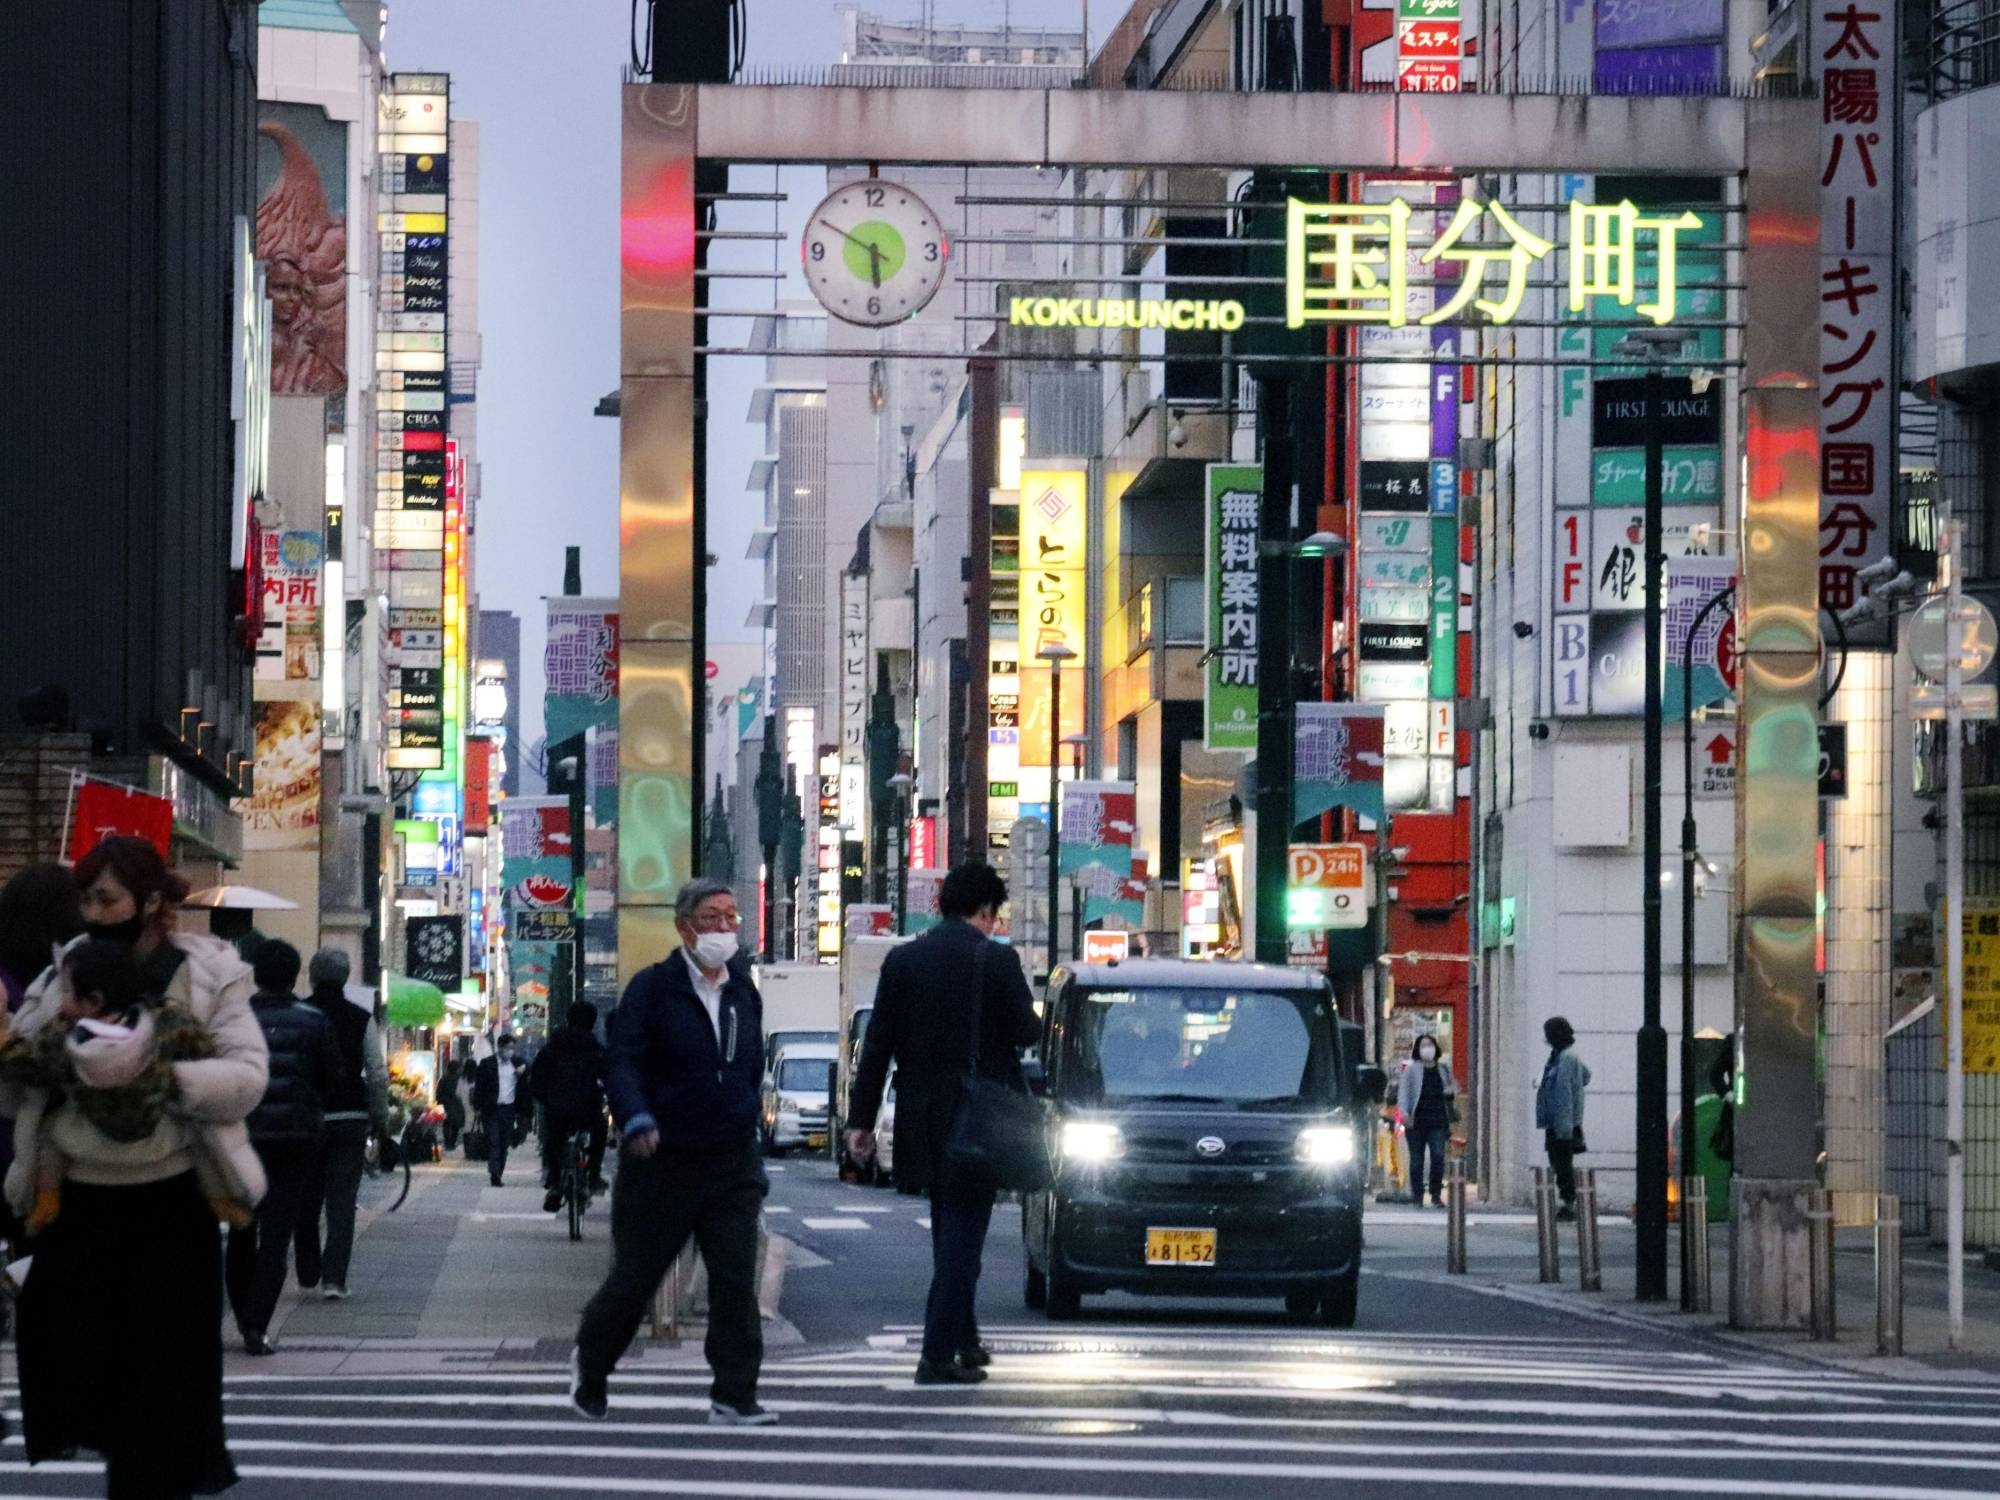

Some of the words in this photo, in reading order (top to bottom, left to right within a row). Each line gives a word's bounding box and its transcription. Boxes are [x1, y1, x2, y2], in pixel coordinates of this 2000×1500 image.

[1403, 32, 1459, 47] ミスティ
[1406, 75, 1456, 91] NEO
[864, 188, 885, 207] 12
[812, 243, 824, 262] 9
[925, 243, 937, 262] 3
[1287, 197, 1703, 328] 国分町
[868, 298, 881, 316] 6
[1010, 298, 1244, 330] KOKUBUNCHO
[1436, 339, 1454, 401] 4F
[1436, 463, 1454, 510] 3F
[1564, 516, 1582, 603] 1F
[1221, 490, 1258, 684] 無料案内所
[1434, 576, 1454, 638] 2F
[1560, 624, 1585, 705] B1
[1438, 708, 1449, 750] 1F
[1328, 861, 1358, 874] 24h
[1162, 1244, 1213, 1261] 81-52
